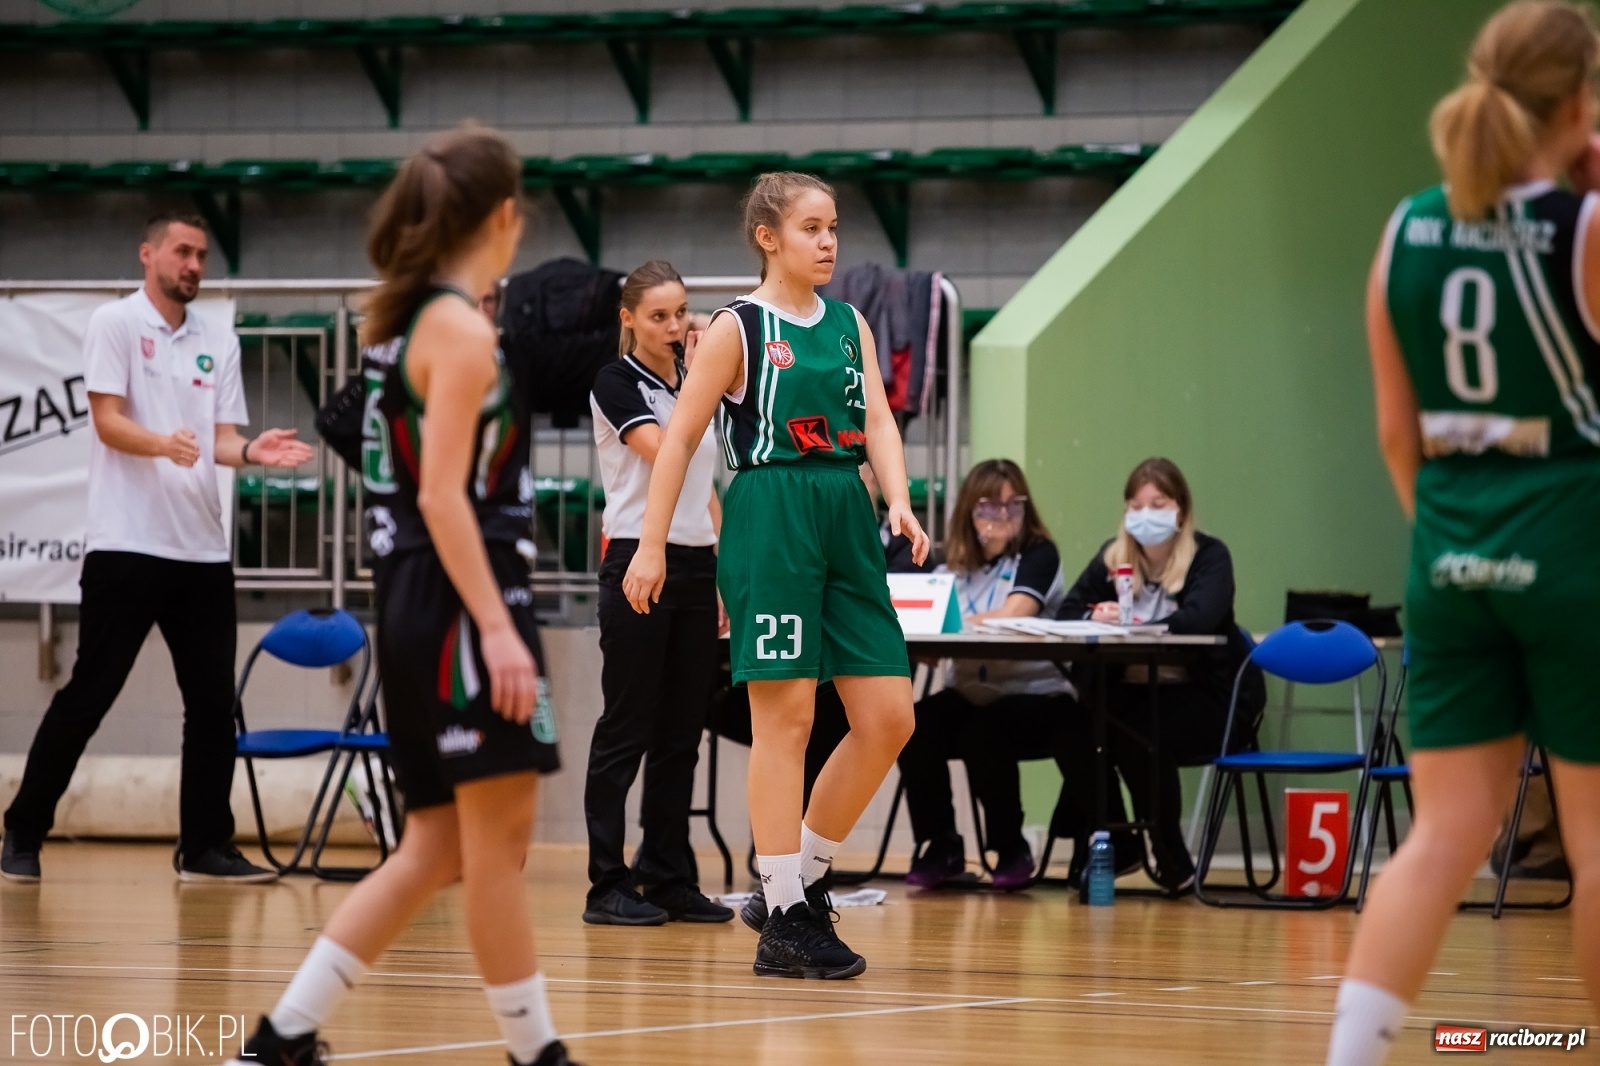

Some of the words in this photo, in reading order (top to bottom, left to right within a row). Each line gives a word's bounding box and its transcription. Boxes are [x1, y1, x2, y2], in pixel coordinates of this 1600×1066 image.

[1440, 267, 1498, 403] 8
[756, 614, 802, 659] 23
[1298, 802, 1339, 875] 5
